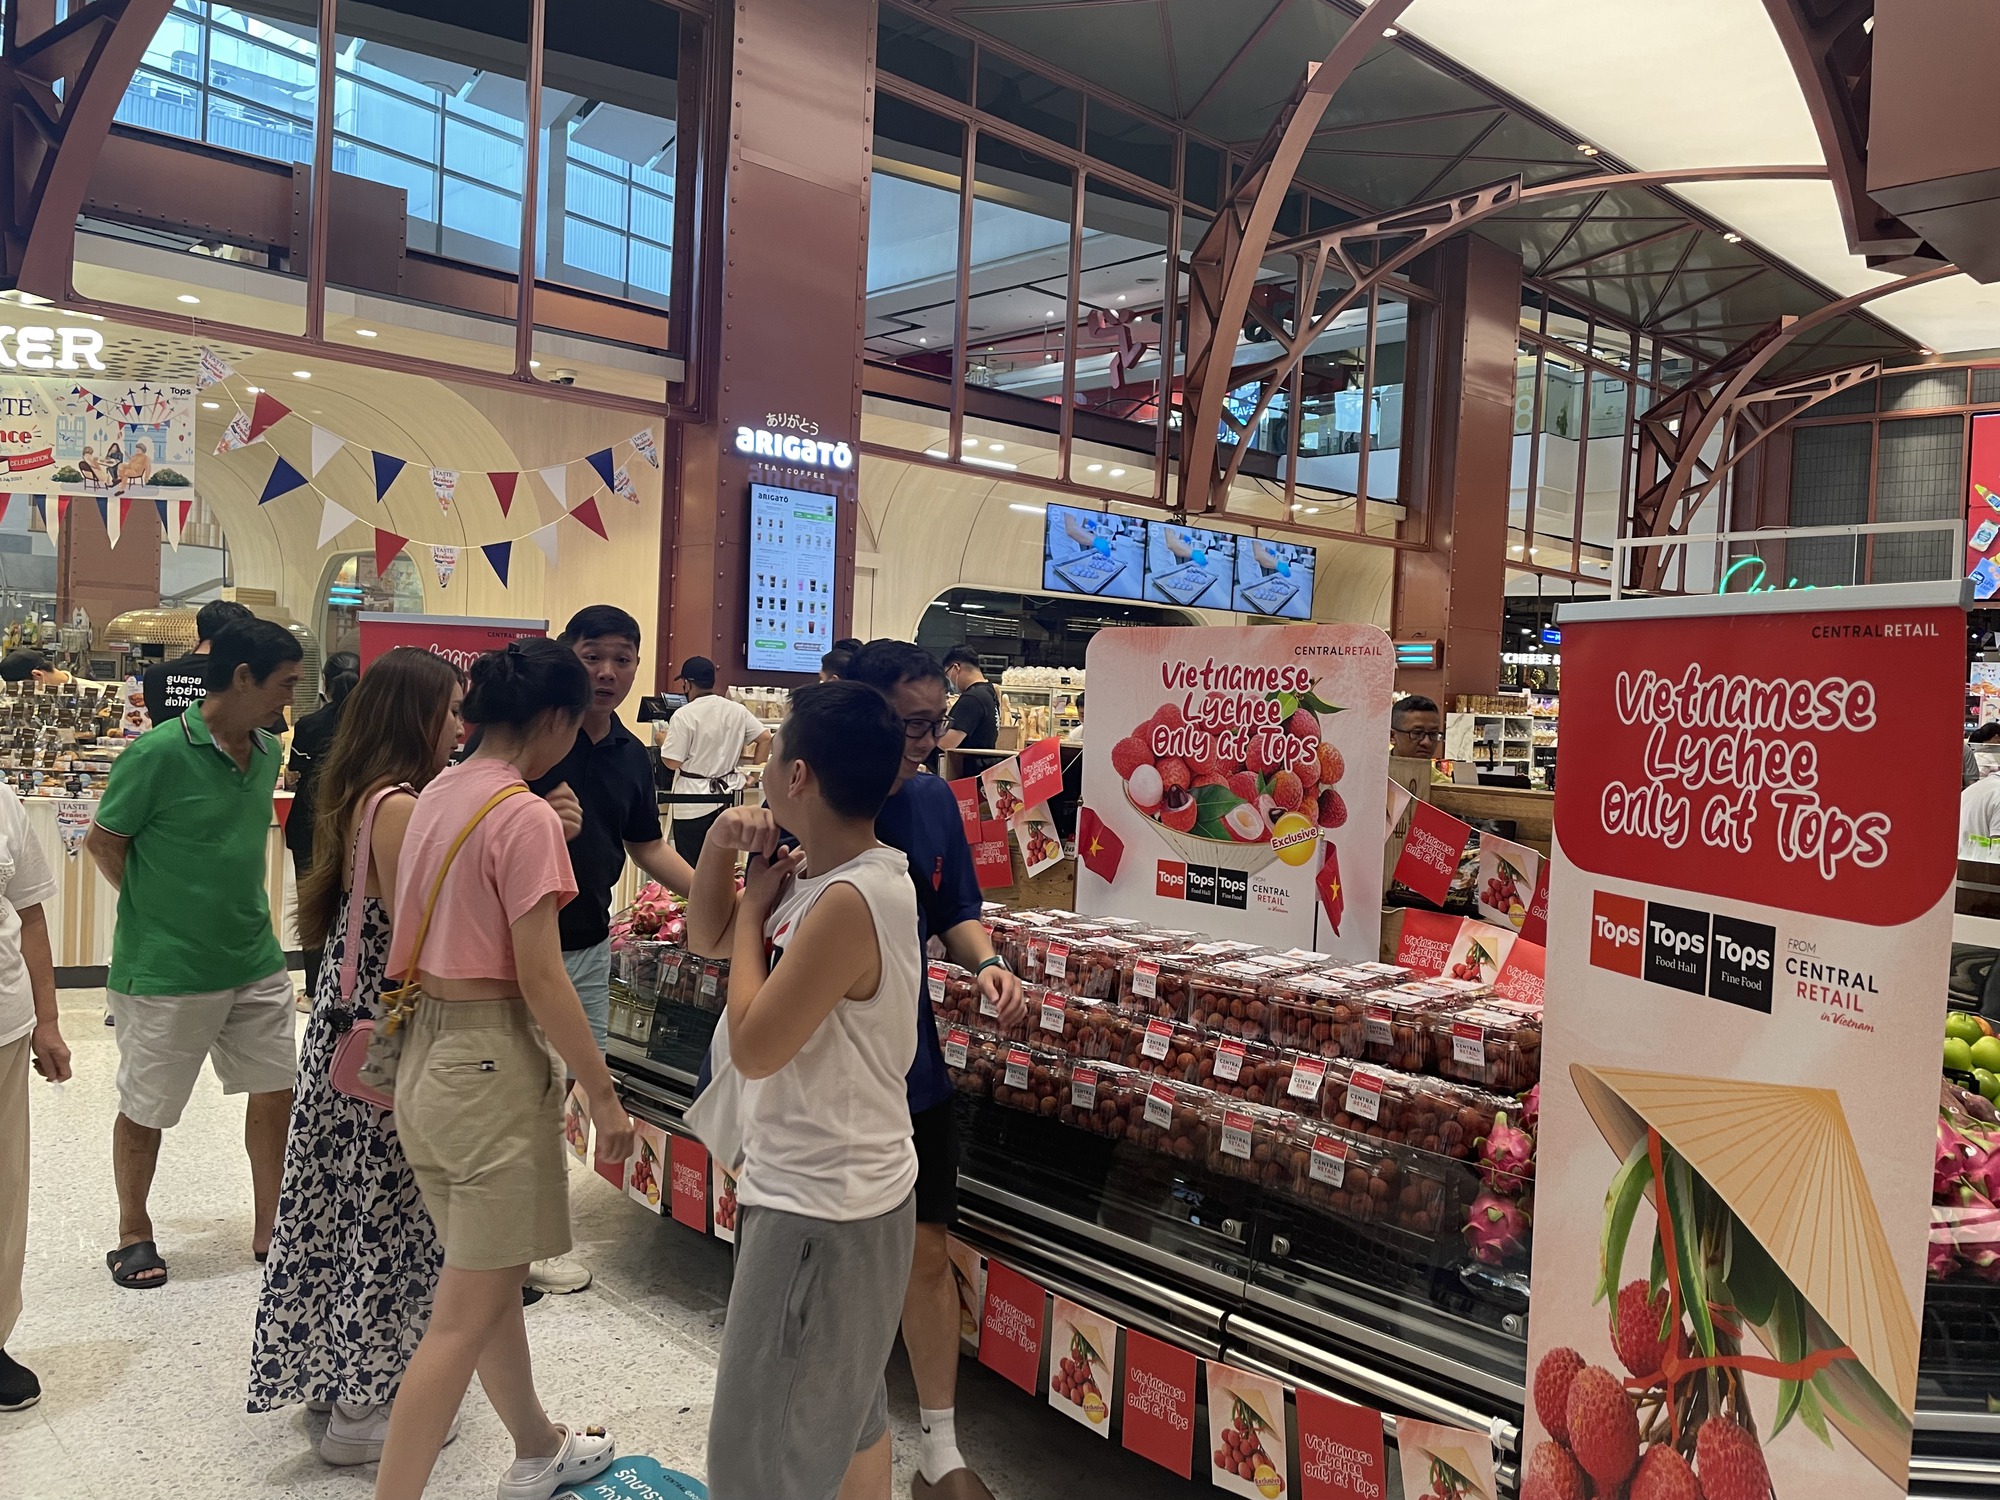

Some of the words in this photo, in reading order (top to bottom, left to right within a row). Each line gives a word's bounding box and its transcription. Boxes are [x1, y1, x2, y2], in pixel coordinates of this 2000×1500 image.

[170, 386, 191, 396] Tops
[0, 398, 33, 416] TE
[766, 412, 819, 436] ありがとう
[10, 454, 49, 466] CELEBRATION
[758, 462, 777, 471] TEA
[787, 467, 825, 479] COFFEE
[1503, 653, 1551, 665] CHEESE
[1161, 657, 1310, 692] Vietnamese
[1615, 662, 1877, 732] Vietnamese
[1182, 691, 1282, 726] Lychee
[1152, 725, 1209, 763] Only
[1217, 726, 1249, 760] at
[1257, 726, 1319, 772] Tops
[1643, 723, 1818, 790] Lychee
[1271, 827, 1317, 850] Exclusive
[1601, 781, 1690, 849] Only
[1700, 788, 1758, 854] at
[1771, 788, 1892, 881] Tops
[1413, 827, 1455, 856] Vietnamese
[1416, 838, 1445, 860] Lychee
[1435, 860, 1452, 875] Tops
[1159, 871, 1184, 886] Tops
[1188, 872, 1214, 888] Tops
[1219, 877, 1246, 892] Tops
[1252, 885, 1290, 897] CENTRAL
[1257, 895, 1284, 905] RETAIL
[1594, 915, 1640, 948] Tops
[1650, 920, 1705, 955] Tops
[1404, 934, 1453, 952] Vietnamese
[1409, 944, 1443, 960] Lychee
[1787, 938, 1817, 953] FROM
[1715, 934, 1770, 971] Tops
[1432, 957, 1446, 971] Top
[1655, 955, 1676, 970] Food
[1677, 959, 1697, 974] Hall
[1721, 971, 1740, 985] Fine
[1741, 976, 1762, 991] Food
[1785, 957, 1879, 994] CENTRAL
[1796, 981, 1864, 1013] RETAIL
[1820, 1012, 1831, 1022] in
[1830, 1012, 1875, 1033] Vietnam
[1146, 1039, 1167, 1048] CENTRAL
[1455, 1043, 1480, 1053] CENTRAL
[1219, 1058, 1241, 1068] CENTRAL
[1293, 1077, 1318, 1087] CENTRAL
[1295, 1083, 1313, 1091] RETAIL
[1074, 1087, 1093, 1097] CENTRAL
[1350, 1093, 1377, 1106] CENTRAL
[1352, 1100, 1372, 1111] RETAIL
[1225, 1133, 1249, 1145] CENTRAL
[1313, 1158, 1341, 1171] CENTRAL
[1317, 1165, 1337, 1177] RETAIL
[990, 1293, 1036, 1329] Vietnamese
[996, 1307, 1026, 1335] Lychee
[1018, 1332, 1036, 1353] Tops
[1130, 1367, 1186, 1402] Vietnamese
[1138, 1383, 1177, 1412] Lychee
[1127, 1392, 1151, 1415] Only
[1151, 1403, 1164, 1419] at
[1167, 1408, 1188, 1431] Tops
[1304, 1433, 1373, 1467] Vietnamese
[1315, 1451, 1362, 1479] Lychee
[1253, 1477, 1281, 1485] Exclusive
[1303, 1462, 1332, 1484] Only
[1333, 1472, 1349, 1488] at
[1351, 1472, 1380, 1499] Tops
